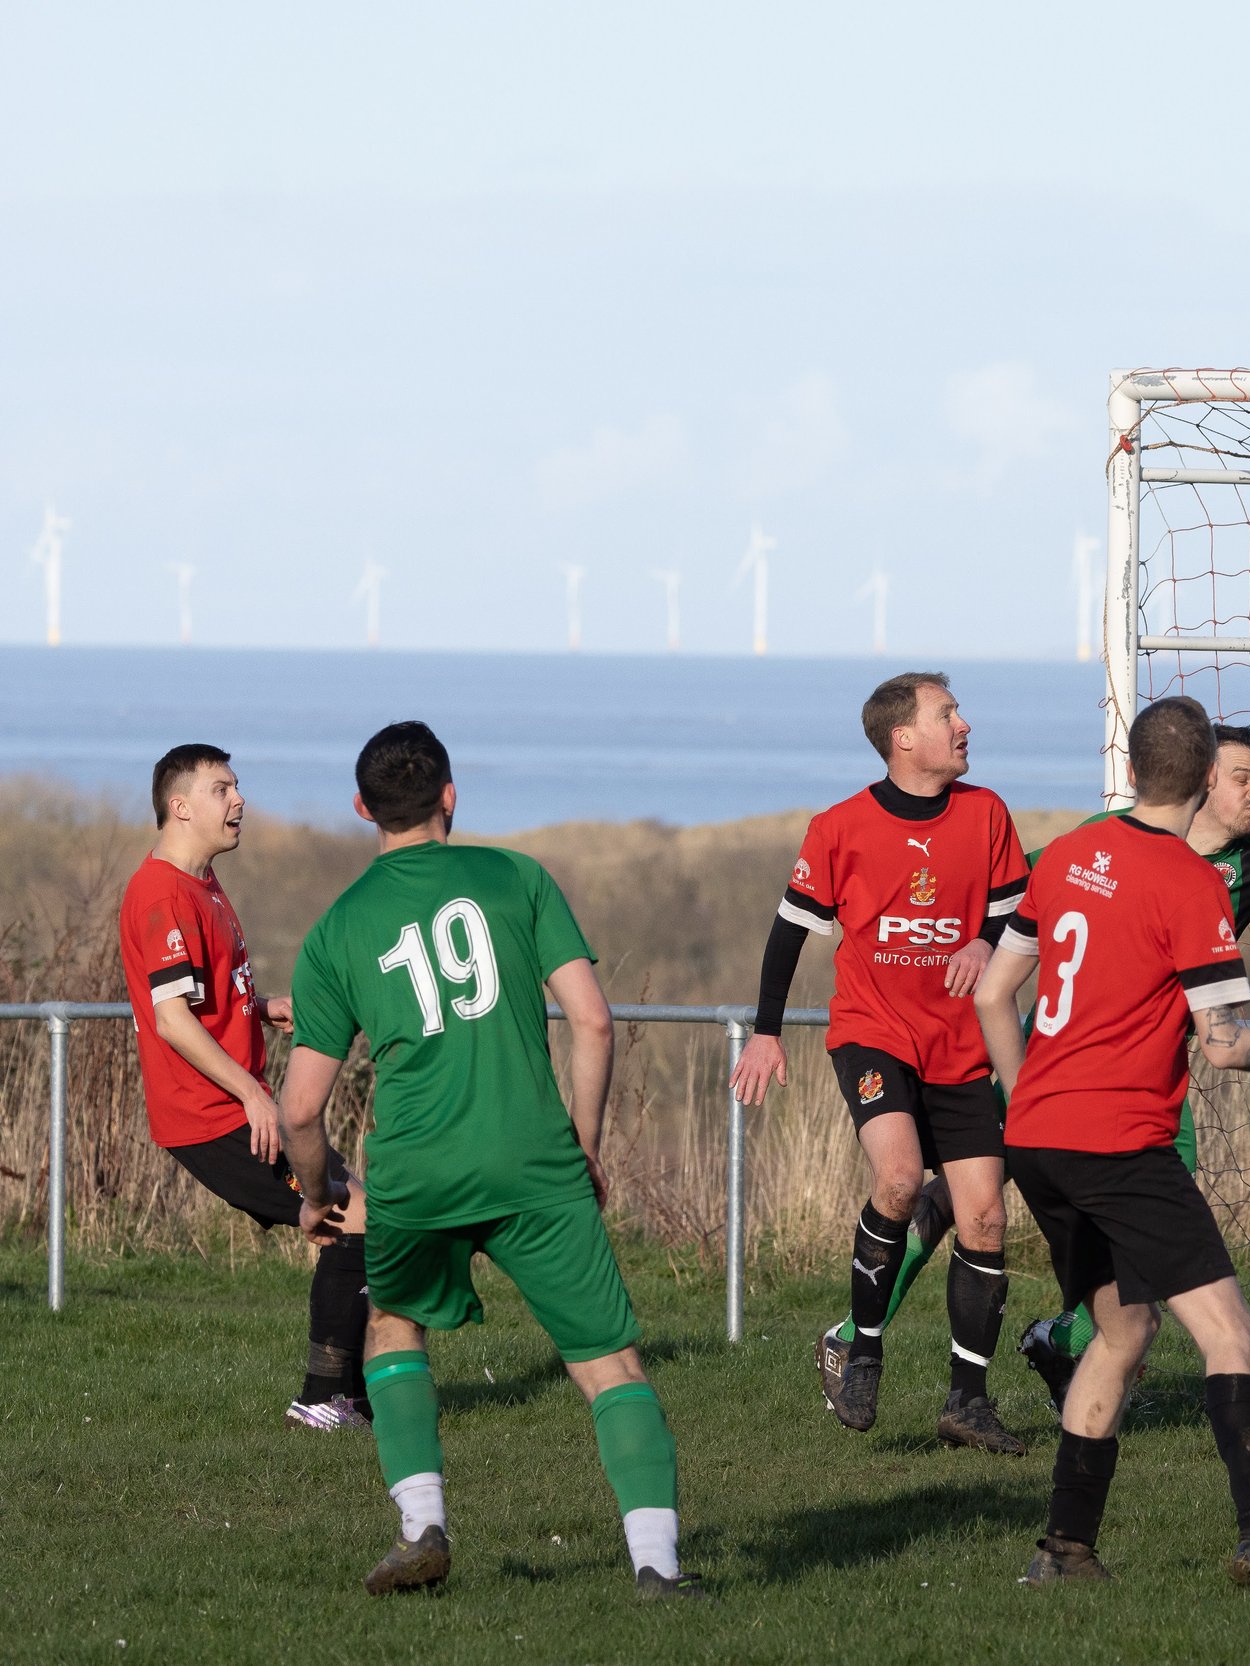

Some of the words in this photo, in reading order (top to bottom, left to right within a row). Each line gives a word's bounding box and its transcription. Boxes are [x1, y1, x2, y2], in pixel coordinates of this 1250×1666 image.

[1065, 874, 1090, 891] cleaning
[1090, 883, 1114, 899] services
[1069, 863, 1083, 876] RG
[1082, 868, 1118, 891] HOWELLS
[877, 915, 962, 945] PSS
[378, 897, 500, 1037] 19
[874, 952, 911, 966] AUTO
[1036, 911, 1088, 1036] 3
